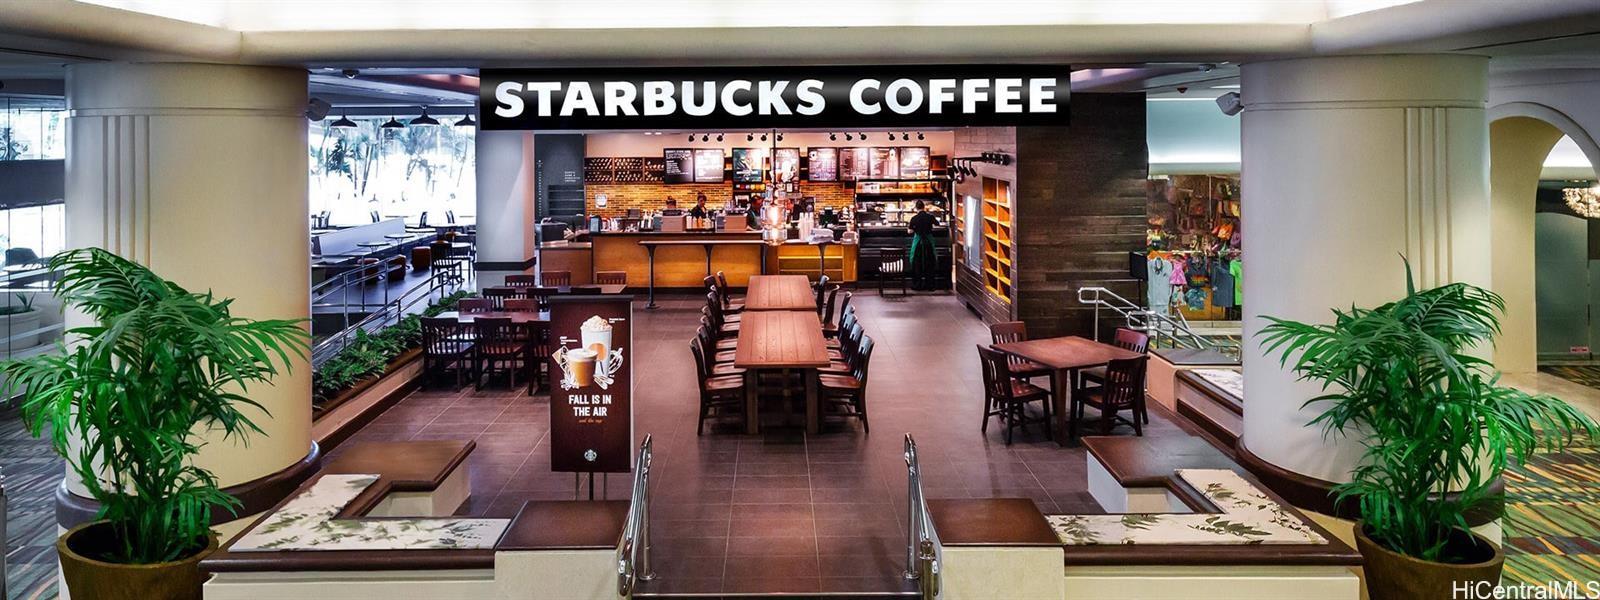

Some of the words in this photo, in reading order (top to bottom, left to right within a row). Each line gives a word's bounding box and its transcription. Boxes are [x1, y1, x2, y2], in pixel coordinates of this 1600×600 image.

[494, 80, 827, 118] STARBUCKS
[849, 77, 1058, 115] COFFEE
[568, 394, 590, 405] FALL
[591, 394, 601, 405] IS
[602, 394, 612, 405] IN
[573, 406, 591, 417] THE
[592, 406, 608, 417] AIR
